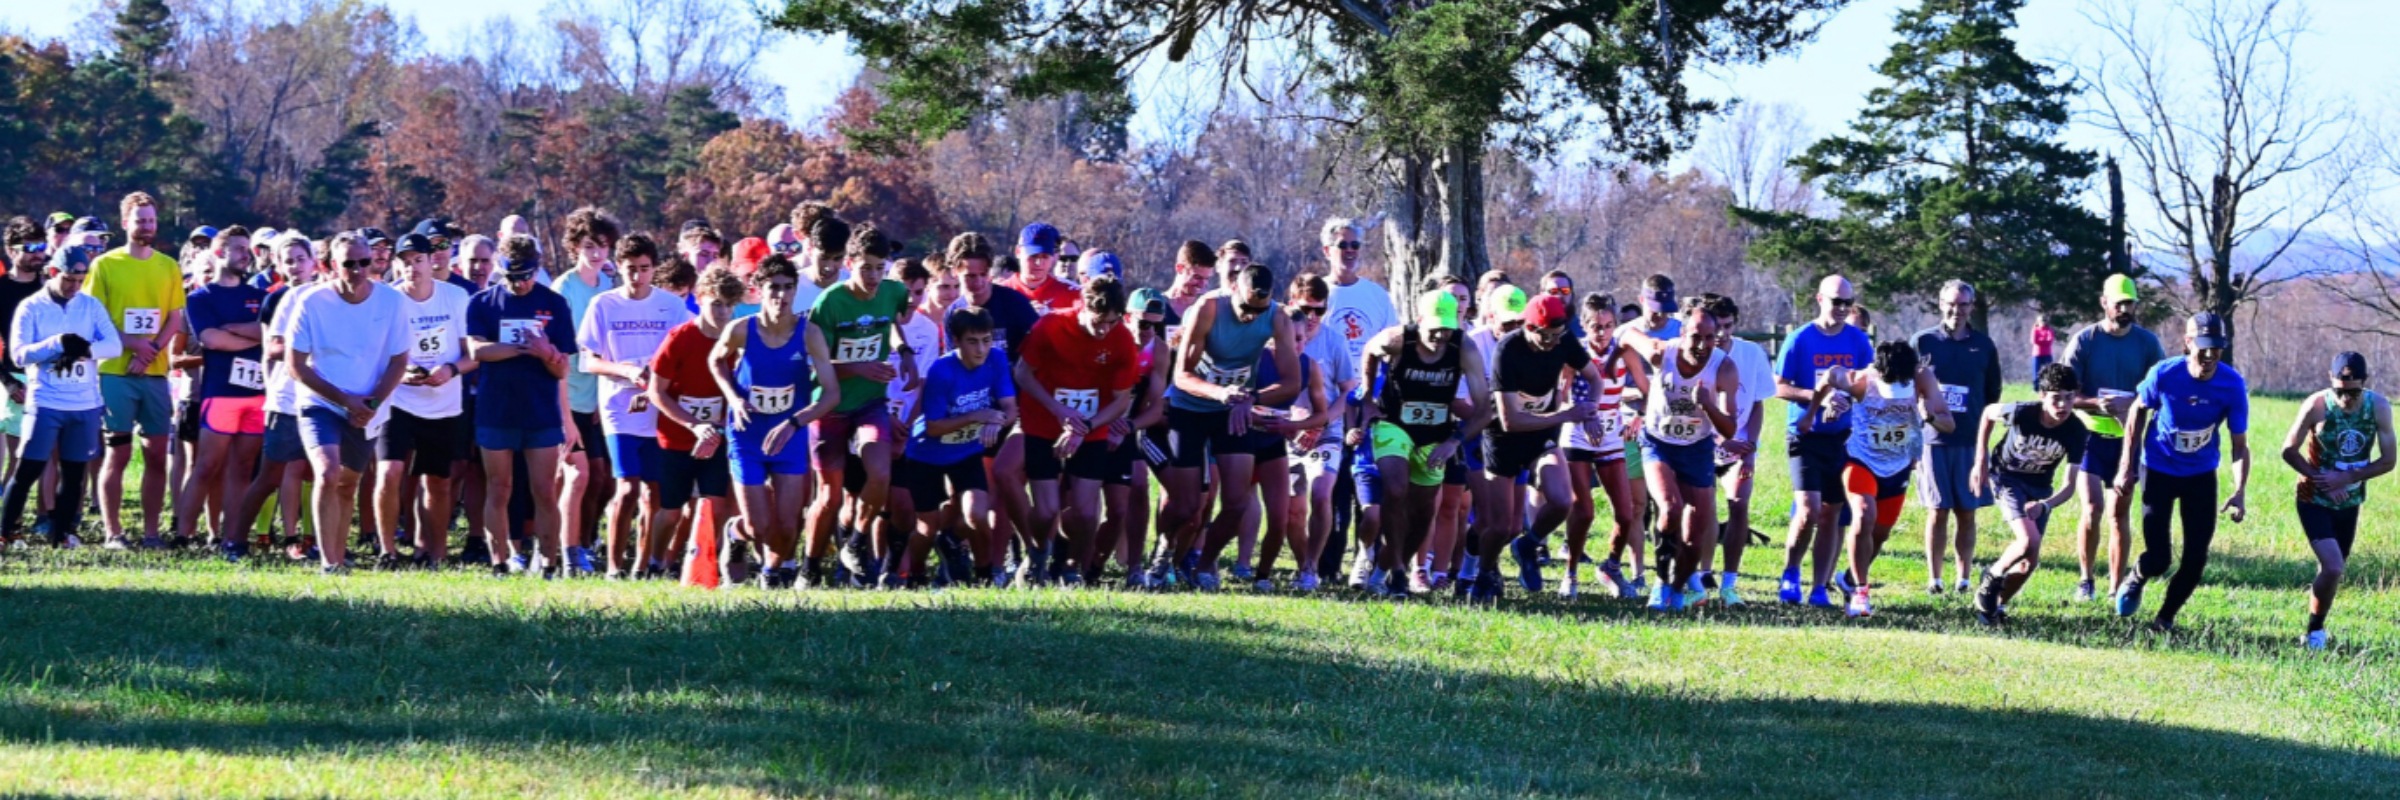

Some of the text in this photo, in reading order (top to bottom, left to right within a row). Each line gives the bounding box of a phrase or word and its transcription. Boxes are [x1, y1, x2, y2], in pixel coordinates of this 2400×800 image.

[133, 315, 155, 330] 32
[418, 335, 441, 352] 65
[844, 343, 877, 359] 175
[1813, 353, 1855, 367] CPTC
[755, 393, 790, 408] 111
[1060, 397, 1093, 412] 171
[689, 406, 712, 420] 75
[1412, 408, 1435, 420] 93
[1663, 423, 1696, 436] 105
[1871, 430, 1906, 445] 149
[1309, 450, 1331, 463] 99
